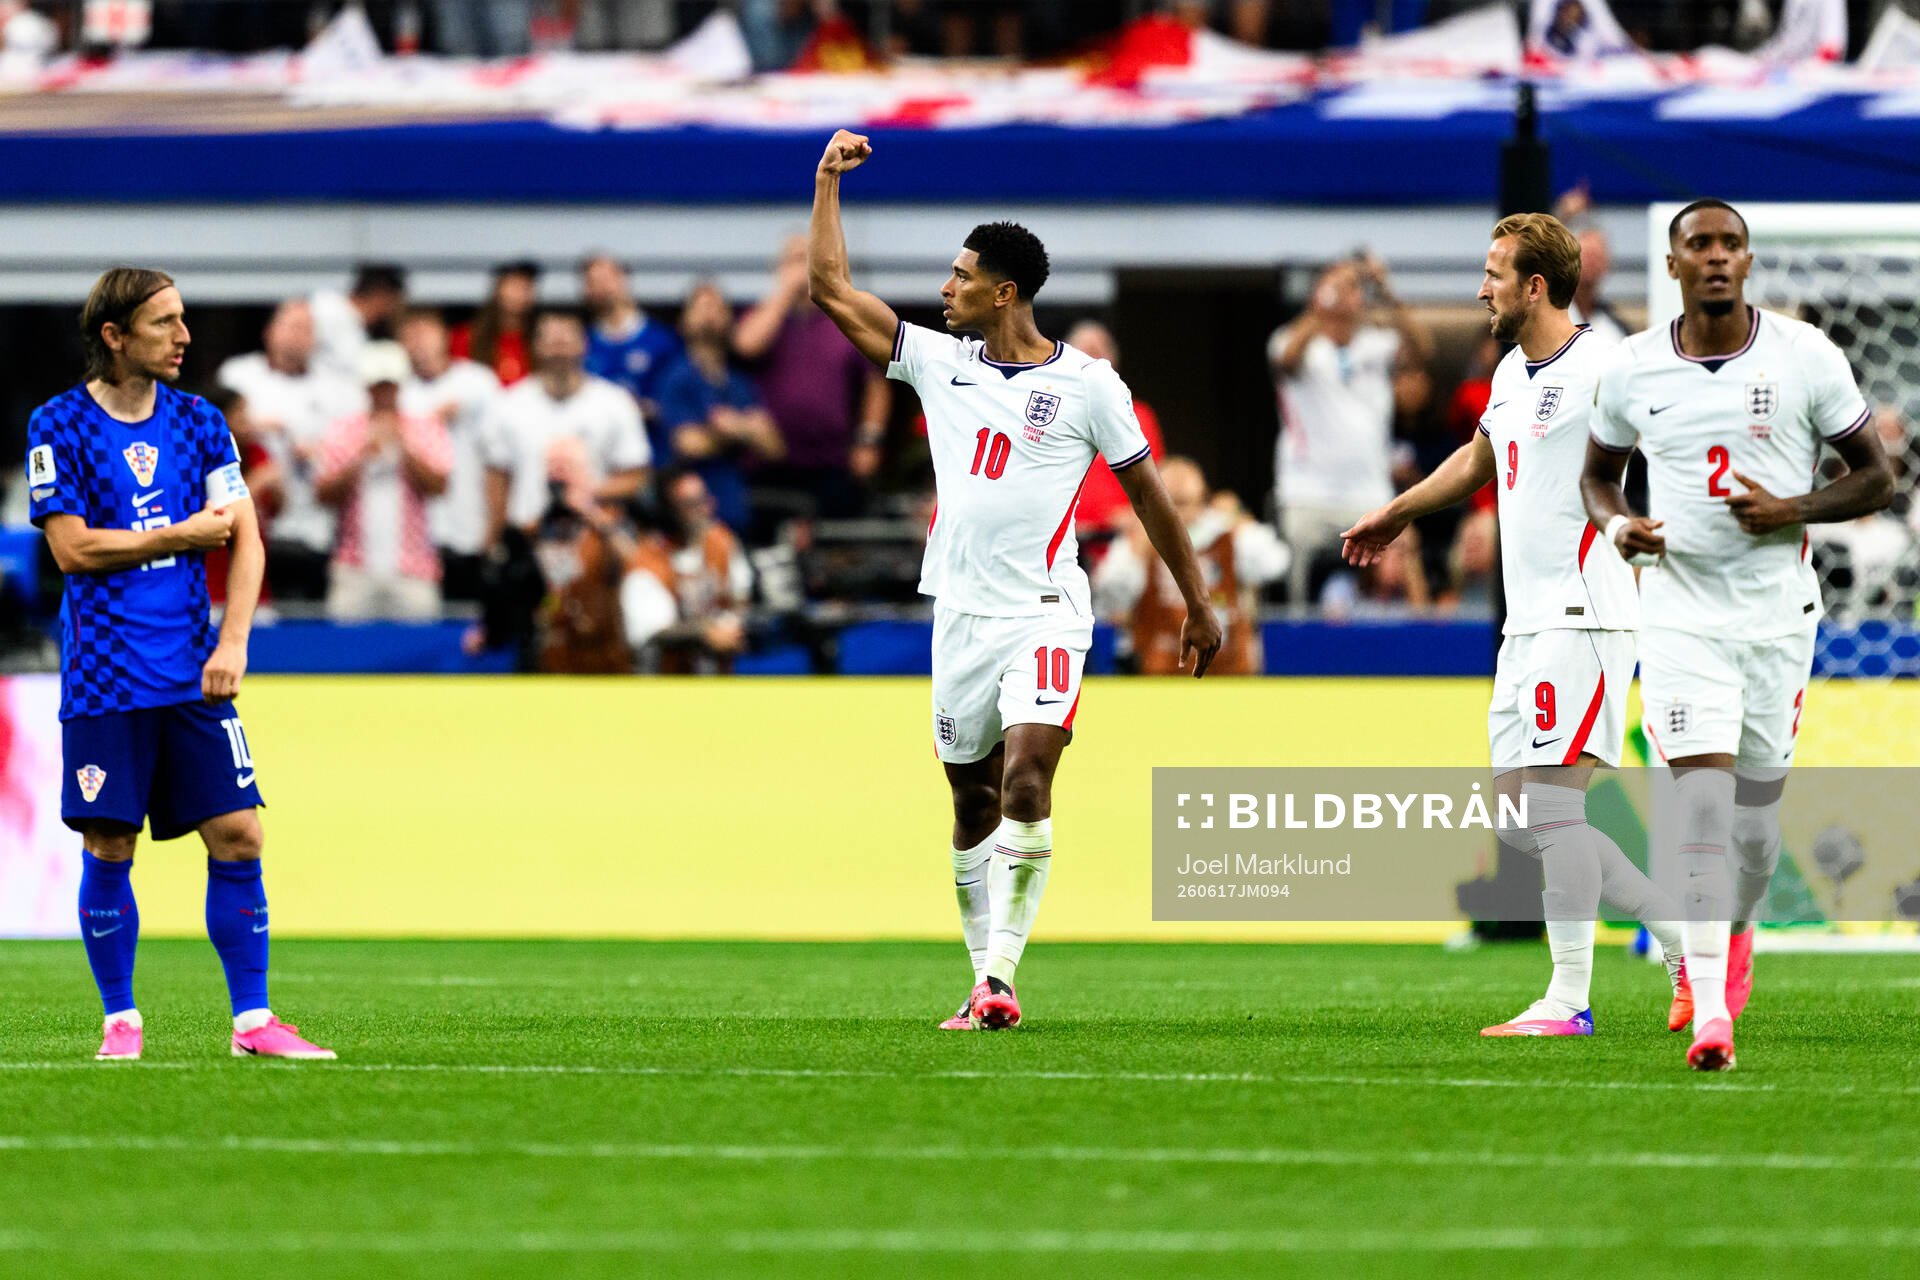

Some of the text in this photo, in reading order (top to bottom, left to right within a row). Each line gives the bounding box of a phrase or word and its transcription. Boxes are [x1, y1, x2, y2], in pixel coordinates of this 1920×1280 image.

[970, 427, 1011, 480] 10
[1507, 440, 1518, 490] 9
[1707, 445, 1731, 497] 2
[1034, 646, 1070, 693] 10
[1535, 681, 1556, 731] 9
